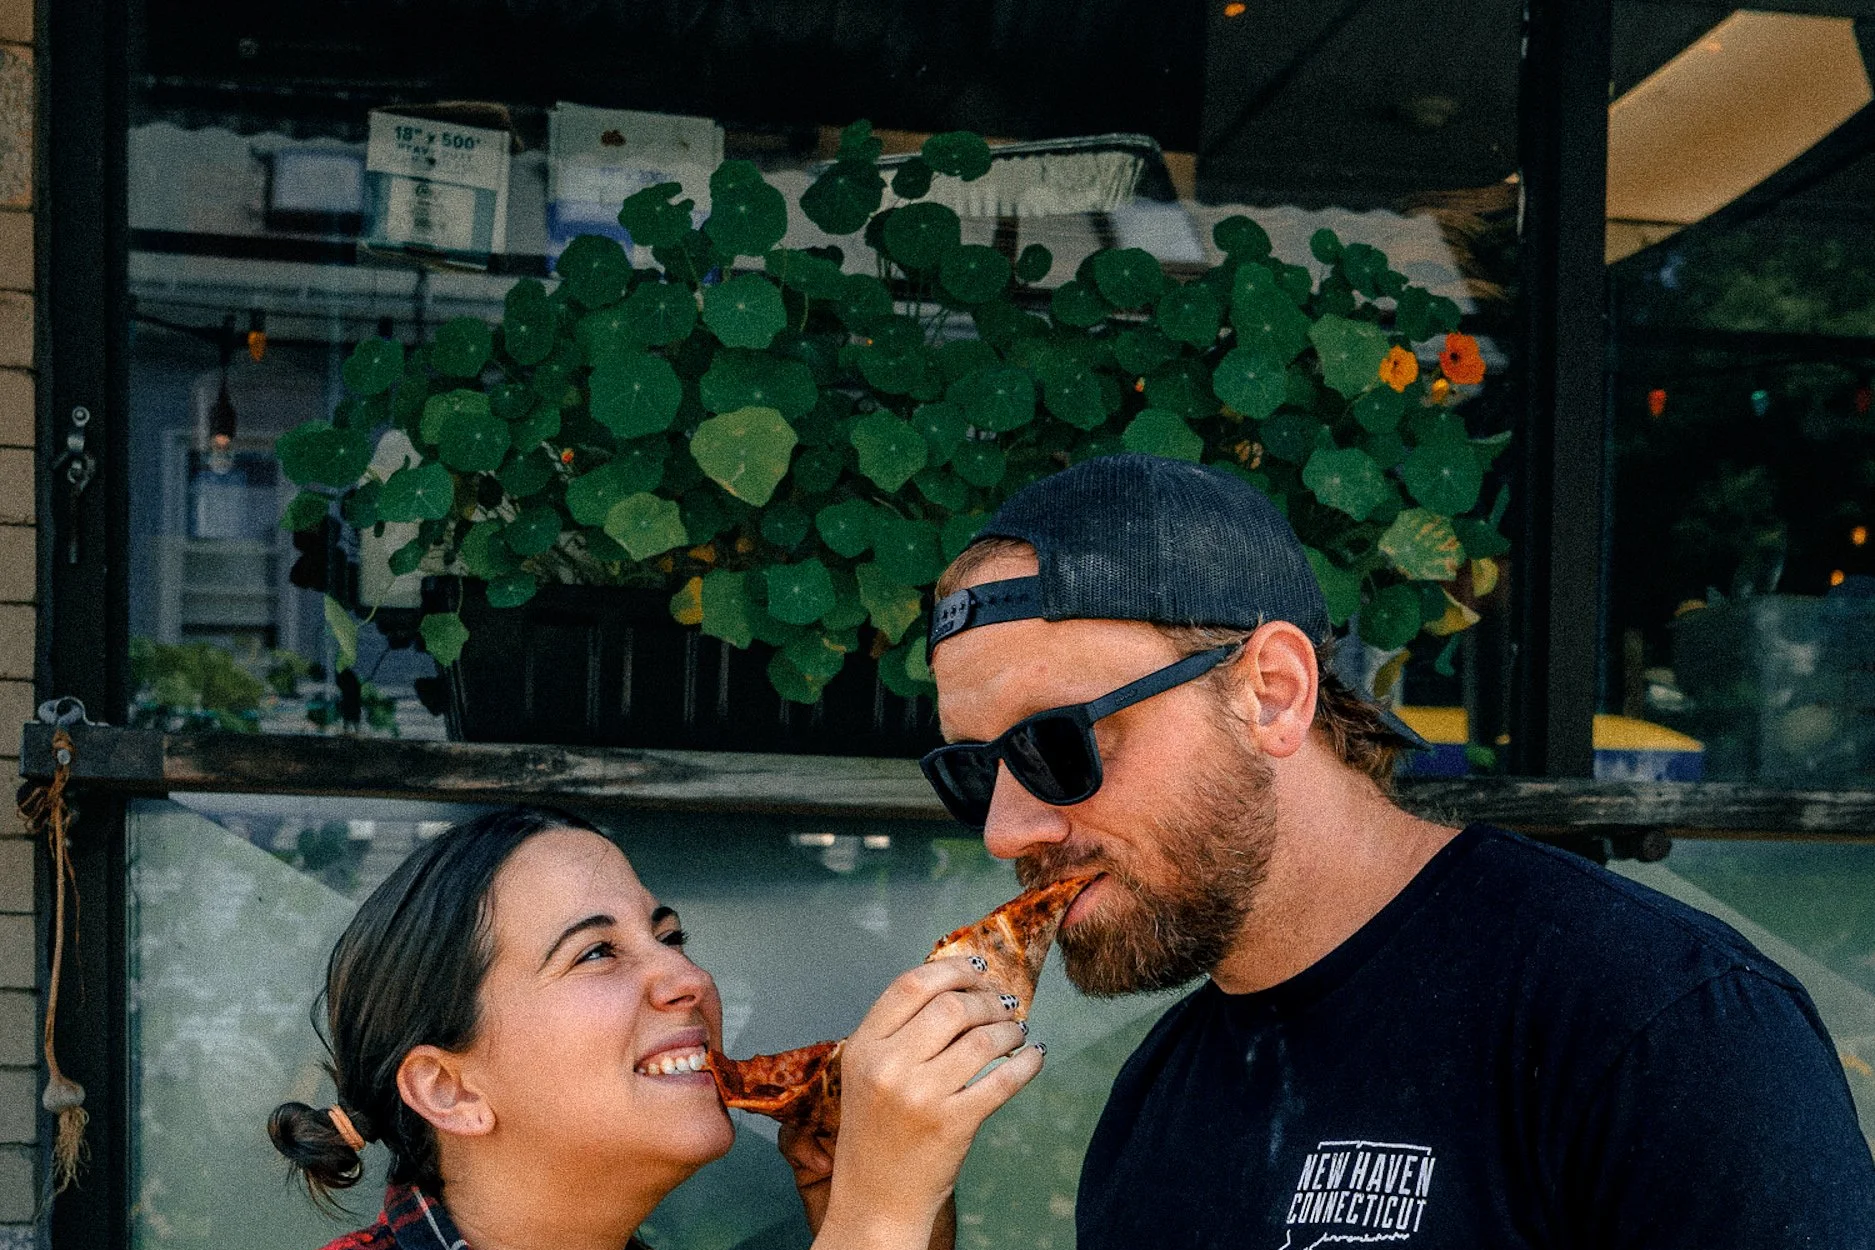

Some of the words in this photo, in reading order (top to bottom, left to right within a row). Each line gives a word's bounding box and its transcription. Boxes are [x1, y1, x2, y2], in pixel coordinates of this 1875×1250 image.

[1297, 1152, 1350, 1191] NEW
[1349, 1152, 1436, 1197] HAVEN
[1286, 1191, 1427, 1232] CONNECTICUT
